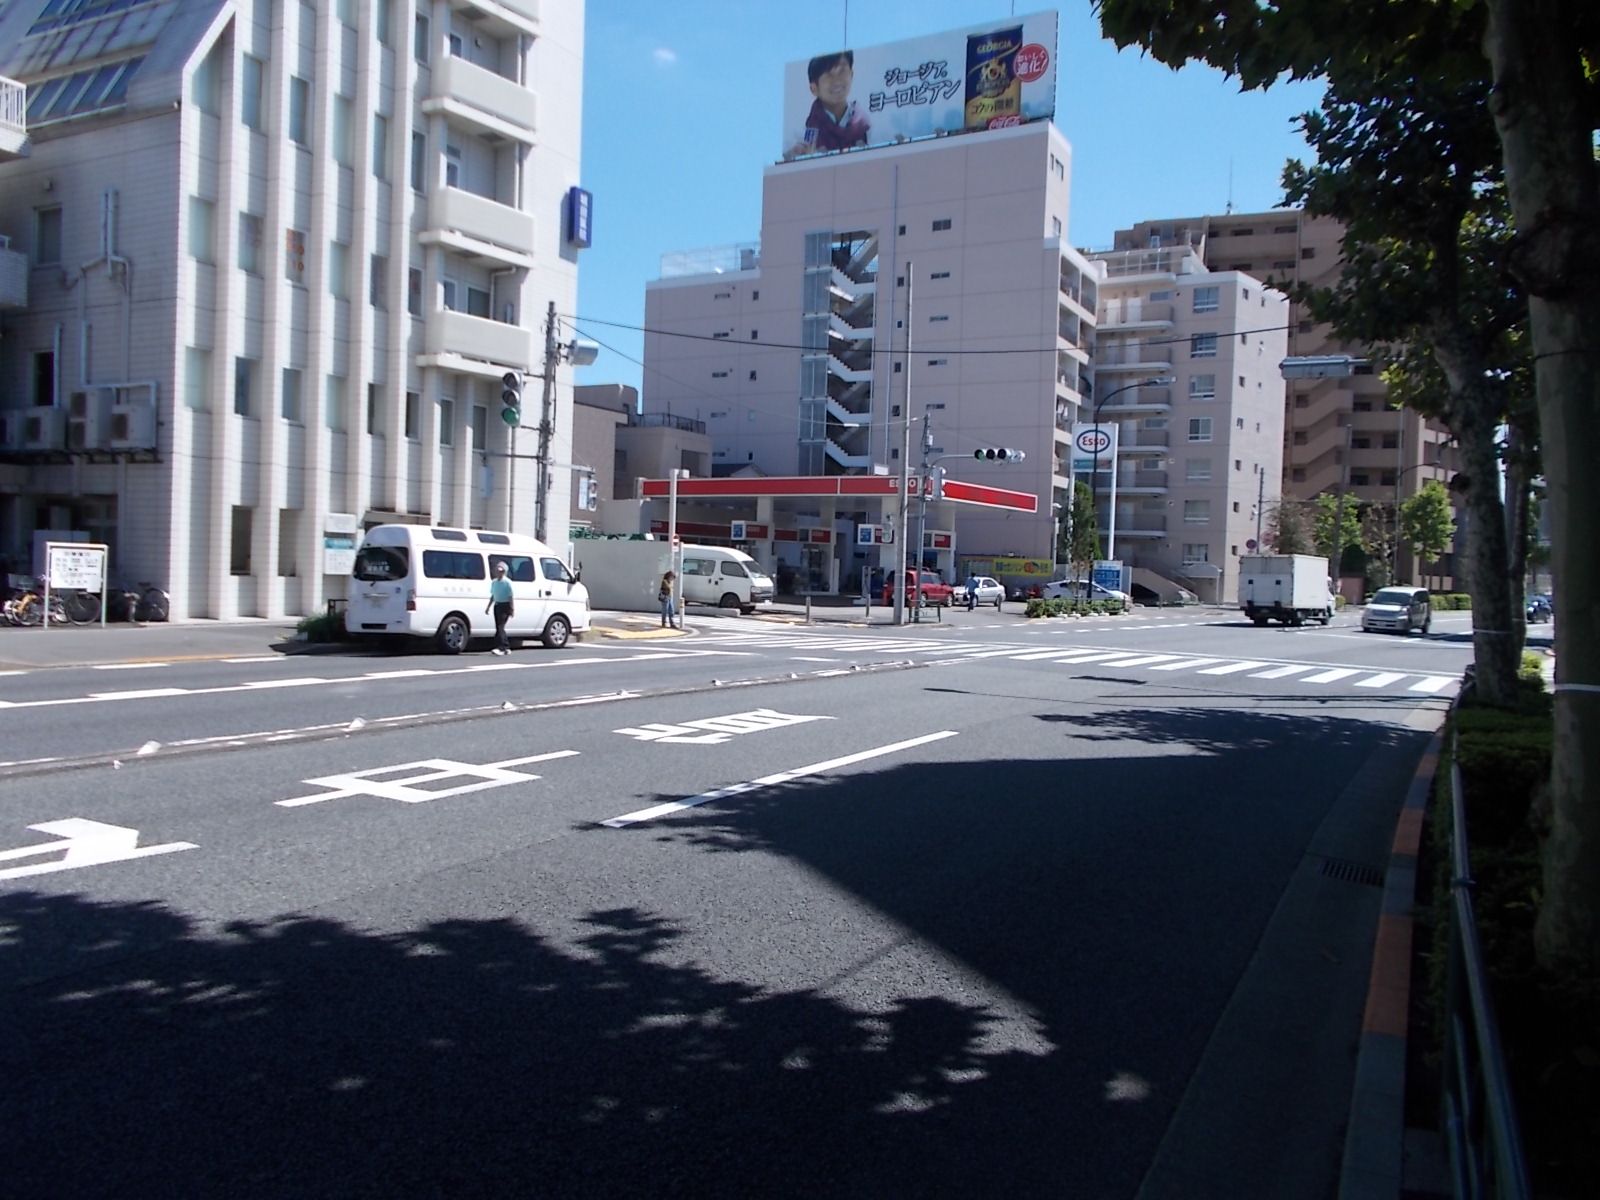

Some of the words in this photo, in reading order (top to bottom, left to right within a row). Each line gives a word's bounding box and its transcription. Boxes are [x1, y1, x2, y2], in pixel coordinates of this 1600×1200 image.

[869, 79, 961, 112] ヨーロピアン
